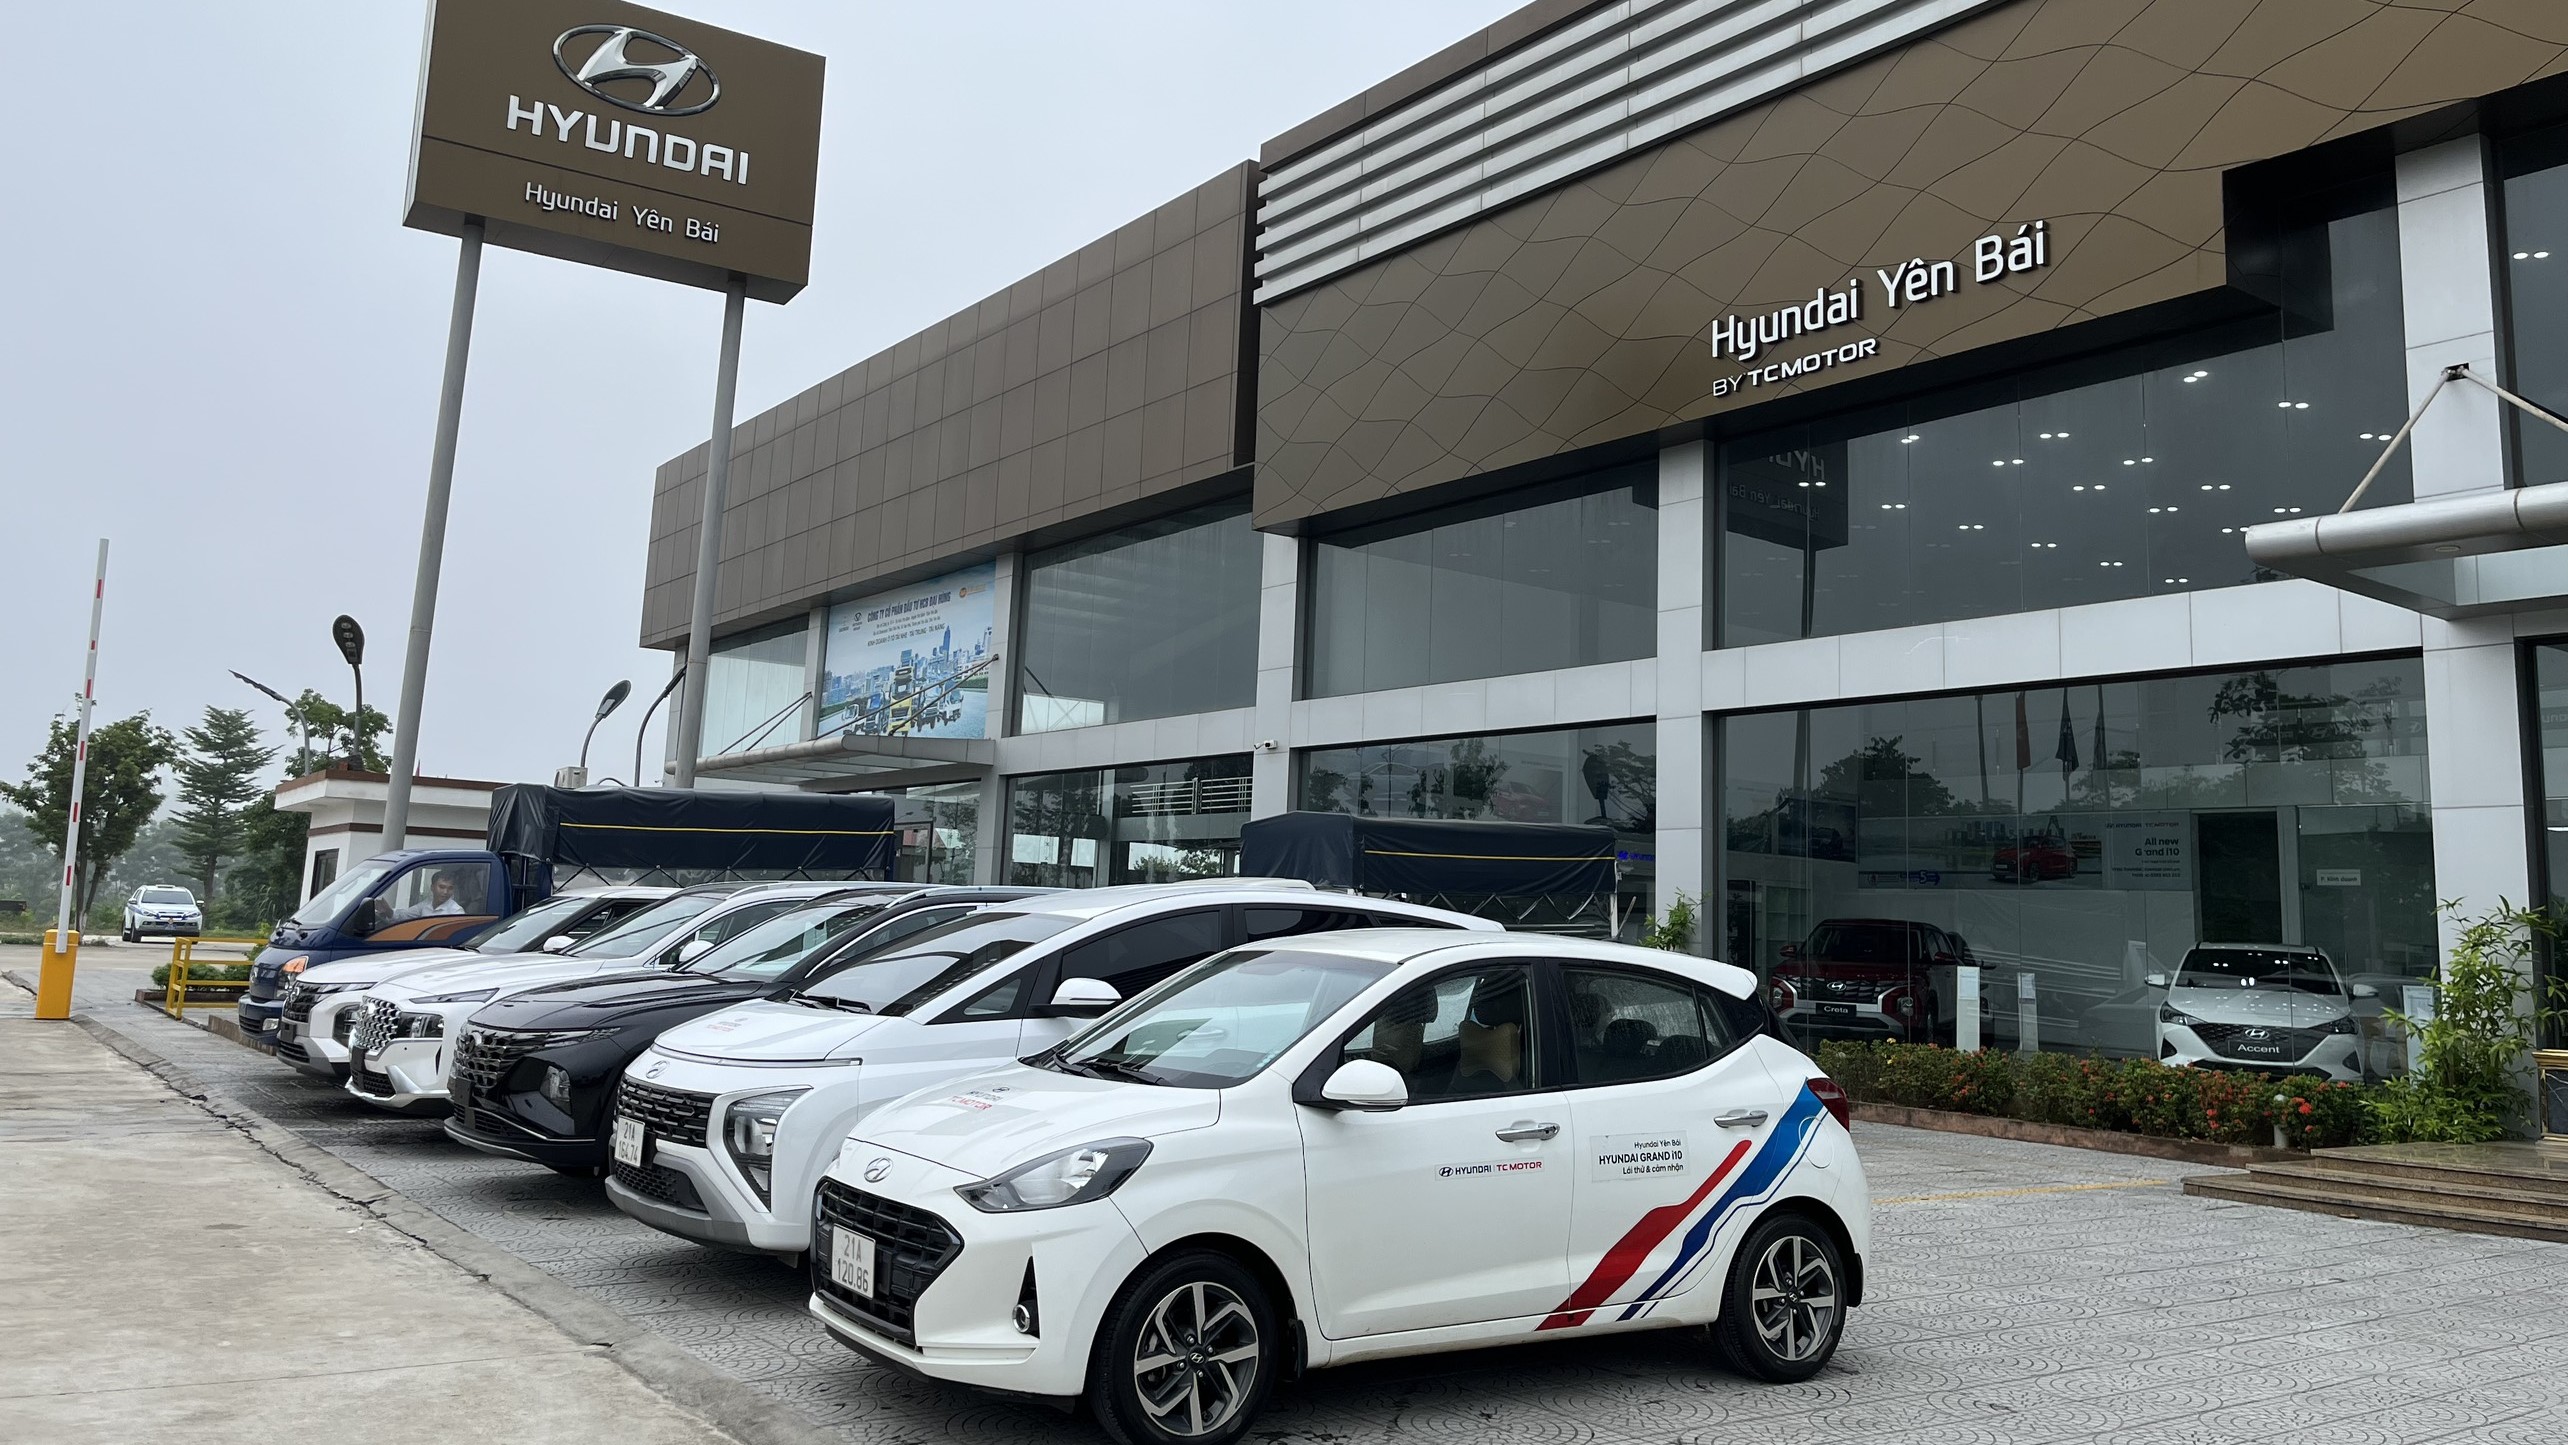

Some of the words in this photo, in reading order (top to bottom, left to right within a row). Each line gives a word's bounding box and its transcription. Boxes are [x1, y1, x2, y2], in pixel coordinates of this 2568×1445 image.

[506, 94, 750, 185] HYUNDAI
[525, 182, 618, 221] Hyundai
[633, 205, 673, 233] Yên
[686, 217, 720, 244] Bái
[1712, 278, 1860, 361] Hyundai
[1877, 257, 1955, 308] Yên
[1975, 220, 2046, 284] Bái
[1713, 374, 1744, 397] BY
[2145, 837, 2157, 846] All
[2158, 838, 2179, 846] new
[2166, 848, 2180, 856] i10
[1824, 1005, 1849, 1014] Creta
[2237, 1044, 2280, 1054] Accent
[1634, 1140, 1659, 1150] Hyundai
[1599, 1153, 1639, 1165] HYUNDAI
[1639, 1151, 1671, 1162] GRAND
[1671, 1150, 1683, 1160] i10
[1455, 1164, 1492, 1175] HYUNDAI
[1496, 1163, 1508, 1172] TC
[1509, 1161, 1543, 1171] MOTOR
[1645, 1165, 1651, 1173] &
[843, 1234, 862, 1263] 21A
[837, 1257, 869, 1293] 120.86
